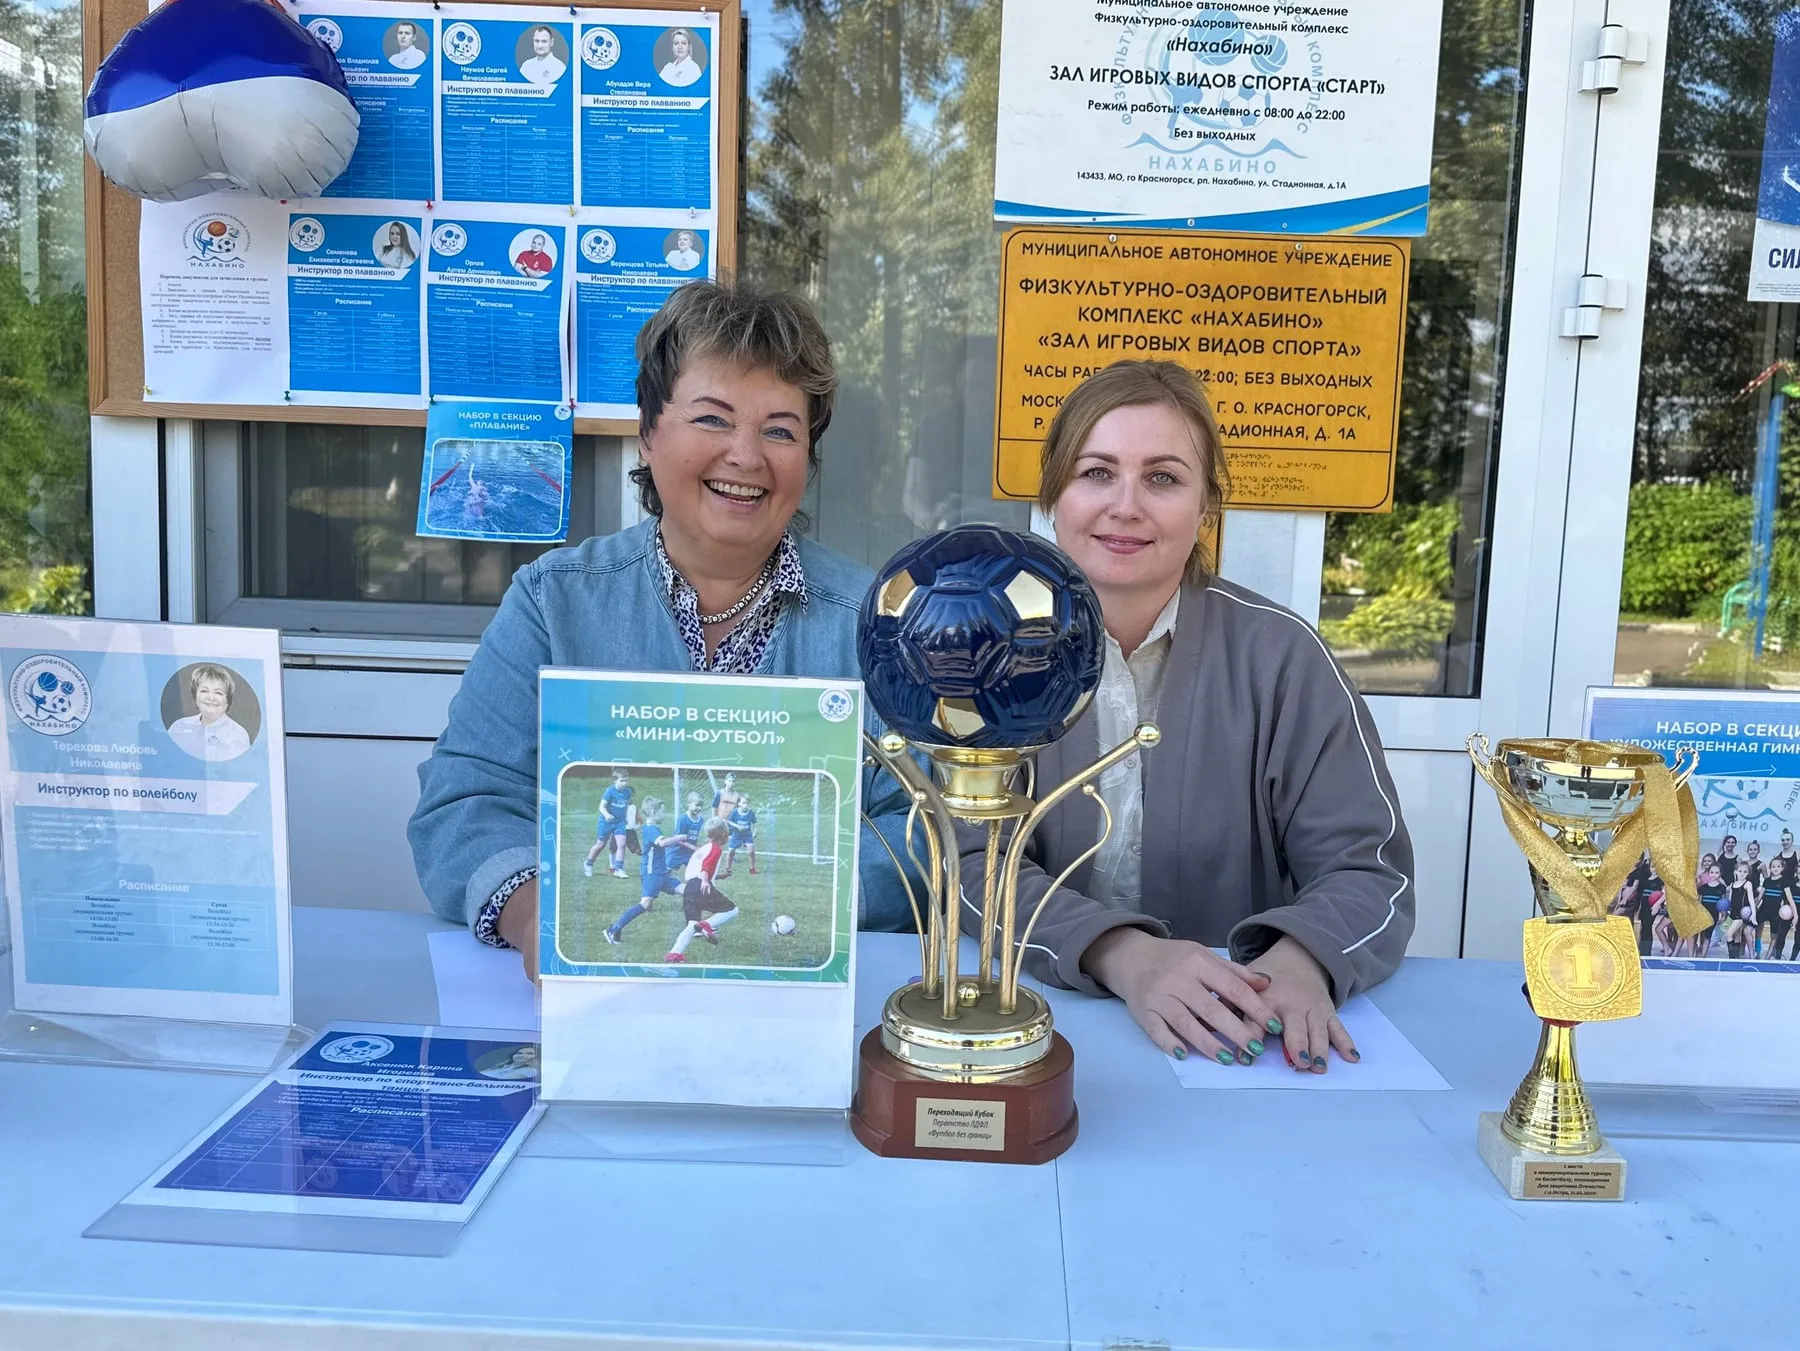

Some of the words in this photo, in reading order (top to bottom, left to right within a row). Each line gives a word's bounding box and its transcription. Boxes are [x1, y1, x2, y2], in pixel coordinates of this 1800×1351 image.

[1196, 1, 1270, 13] автономное
[1273, 5, 1349, 17] учреждение
[1094, 12, 1288, 32] Физкультурно-оздоровительный
[1291, 23, 1349, 34] комплекс
[1166, 37, 1273, 56] «Нахабино»
[1049, 66, 1084, 82] ЗАЛ
[1089, 68, 1170, 87] ИГРОВЫХ
[1176, 72, 1237, 91] ВИДОВ
[1241, 74, 1311, 92] СПОРТА
[1317, 78, 1385, 95] «СТАРТ»
[447, 85, 492, 94] Инструктор
[593, 97, 638, 106] Инструктор
[650, 99, 691, 107] плаванию
[1087, 100, 1128, 112] Режим
[1131, 102, 1180, 116] работы:
[1183, 105, 1250, 118] ежедневно
[1253, 109, 1261, 118] с
[1264, 107, 1294, 119] 08:00
[1296, 110, 1313, 121] до
[1315, 108, 1346, 121] 22:00
[1173, 127, 1194, 139] Без
[1196, 131, 1257, 142] выходных
[1148, 155, 1278, 175] НАХАБИНО
[1076, 171, 1107, 182] 143433,
[1108, 173, 1125, 183] МО,
[1127, 175, 1137, 183] го
[1138, 174, 1194, 187] Красногорск,
[1196, 177, 1210, 187] рп.
[1212, 177, 1255, 188] Нахабино,
[1257, 180, 1269, 189] ул.
[1272, 179, 1325, 190] Стадионная,
[1327, 180, 1347, 191] д.1А
[1021, 243, 1163, 260] МУНИЦИПАЛЬНОЕ
[1169, 248, 1278, 264] АВТОНОМНОЕ
[1284, 251, 1392, 268] УЧРЕЖДЕНИЕ
[297, 266, 342, 275] Инструктор
[354, 269, 395, 277] плаванию
[438, 273, 484, 284] Инструктор
[496, 279, 538, 287] плаванию
[590, 275, 636, 285] Инструктор
[1018, 278, 1388, 305] ФИЗКУЛЬТУРНО-ОЗДОРОВИТЕЛЬНЫЙ
[1077, 307, 1183, 325] КОМПЛЕКС
[1190, 310, 1323, 329] «НАХАБИНО»
[1038, 332, 1090, 349] «ЗАЛ
[1097, 333, 1190, 352] ИГРОВЫХ
[1198, 338, 1265, 356] ВИДОВ
[1272, 340, 1361, 357] СПОРТА»
[1024, 364, 1067, 378] ЧАСЫ
[1244, 371, 1275, 386] БЕЗ
[1280, 372, 1373, 388] ВЫХОДНЫХ
[458, 411, 491, 420] НАБОР
[493, 412, 499, 420] В
[501, 413, 542, 422] СЕКЦИЮ
[1216, 401, 1227, 414] Г.
[1233, 402, 1248, 415] О.
[1254, 403, 1371, 420] КРАСНОГОРСК,
[469, 422, 531, 431] «ПЛАВАНИЕ»
[1034, 417, 1046, 430] Р.
[1218, 424, 1309, 441] АДИОННАЯ,
[1314, 427, 1331, 442] Д.
[1337, 427, 1356, 440] 1А
[611, 704, 681, 721] НАБОР
[686, 707, 698, 721] В
[703, 708, 791, 725] СЕКЦИЮ
[29, 721, 77, 729] НАХАБИНО
[1656, 721, 1722, 736] НАБОР
[1727, 723, 1738, 736] В
[615, 726, 786, 745] «МИНИ-ФУТБОЛ»
[52, 740, 109, 754] Терехова
[111, 742, 158, 755] Любовь
[70, 756, 143, 771] Николаевна
[37, 782, 110, 799] Инструктор
[113, 787, 130, 798] по
[132, 786, 198, 803] волейболу
[1700, 818, 1769, 832] АХАБИНО
[118, 879, 190, 893] Расписание
[1563, 944, 1600, 990] 1
[299, 1072, 374, 1084] Инструктор
[395, 1078, 527, 1091] спортивно-бальным
[381, 1085, 431, 1094] танцам
[349, 1106, 428, 1117] Расписание
[927, 1107, 974, 1119] Переходящий
[974, 1109, 995, 1119] Кубок
[956, 1130, 966, 1139] без
